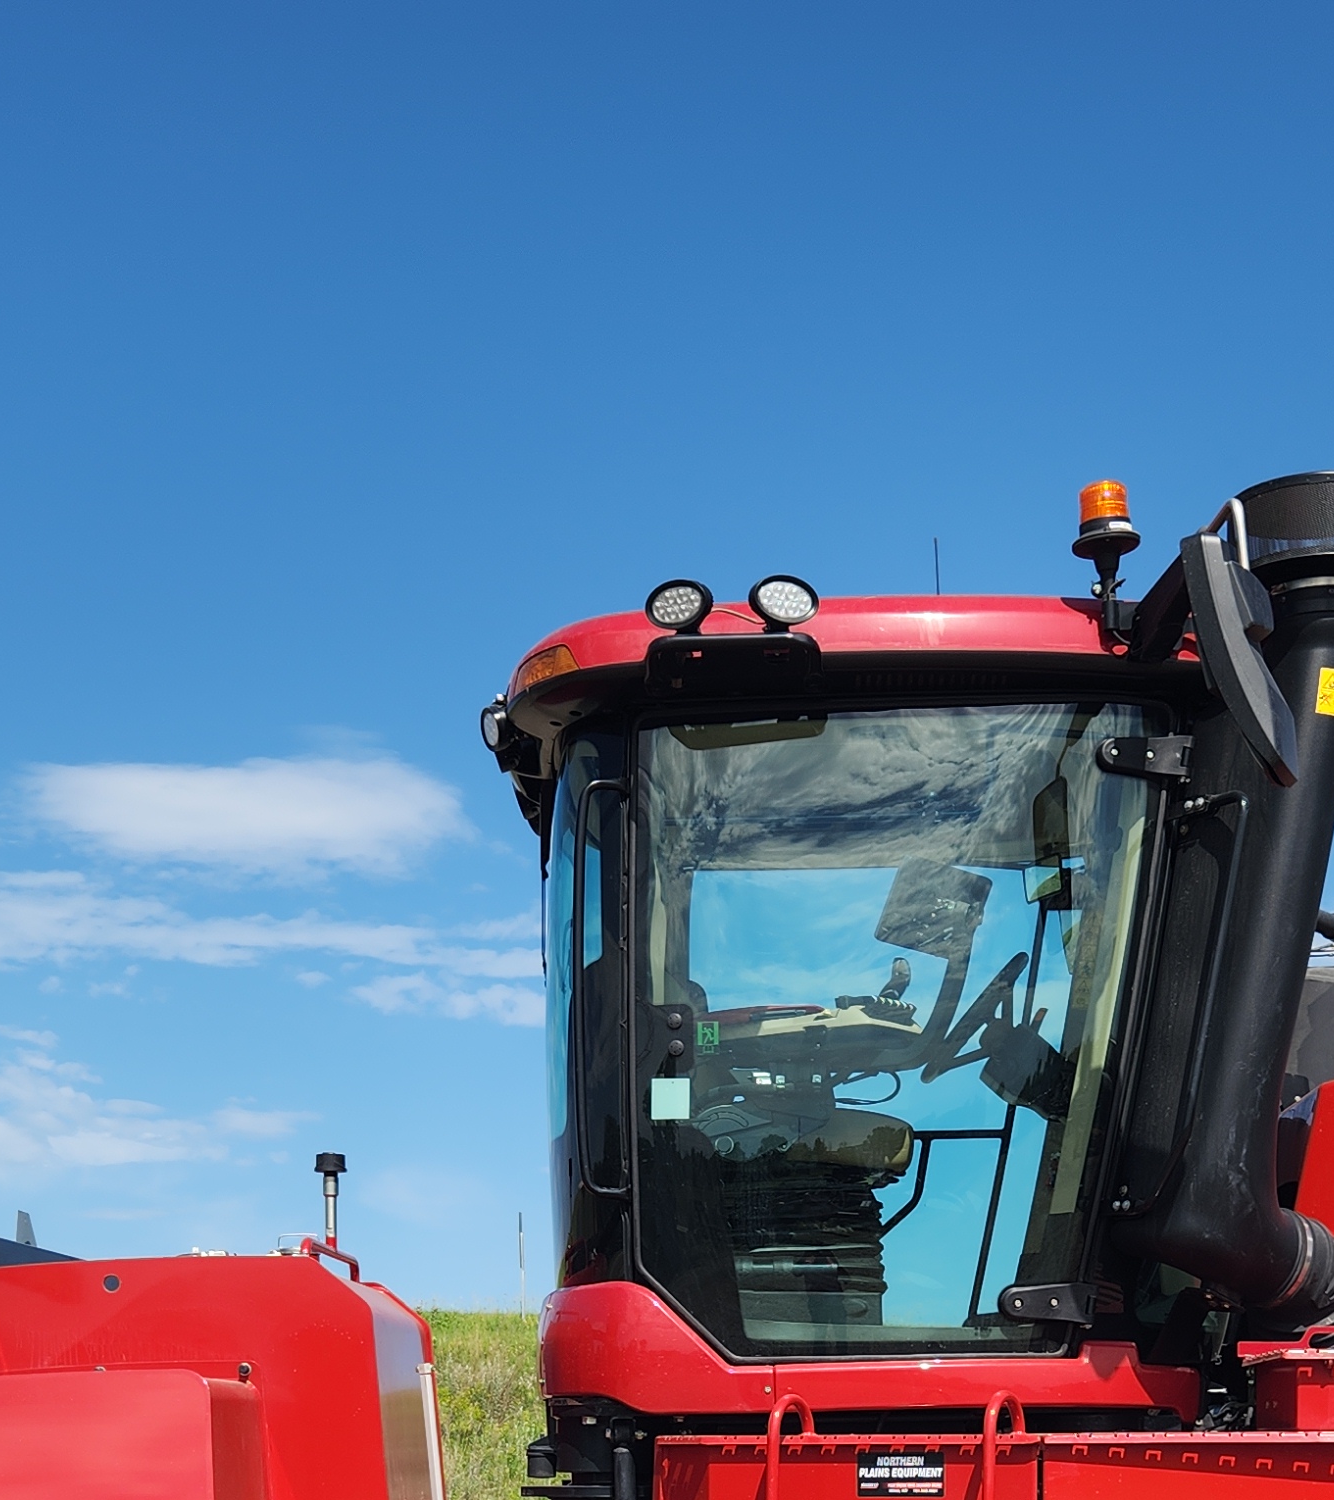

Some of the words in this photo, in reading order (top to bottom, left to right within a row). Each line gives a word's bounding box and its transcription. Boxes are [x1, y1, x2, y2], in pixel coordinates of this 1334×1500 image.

[876, 1456, 924, 1466] NORTHERN
[859, 1467, 890, 1478] PLAINS
[891, 1467, 943, 1478] EQUIPMENT
